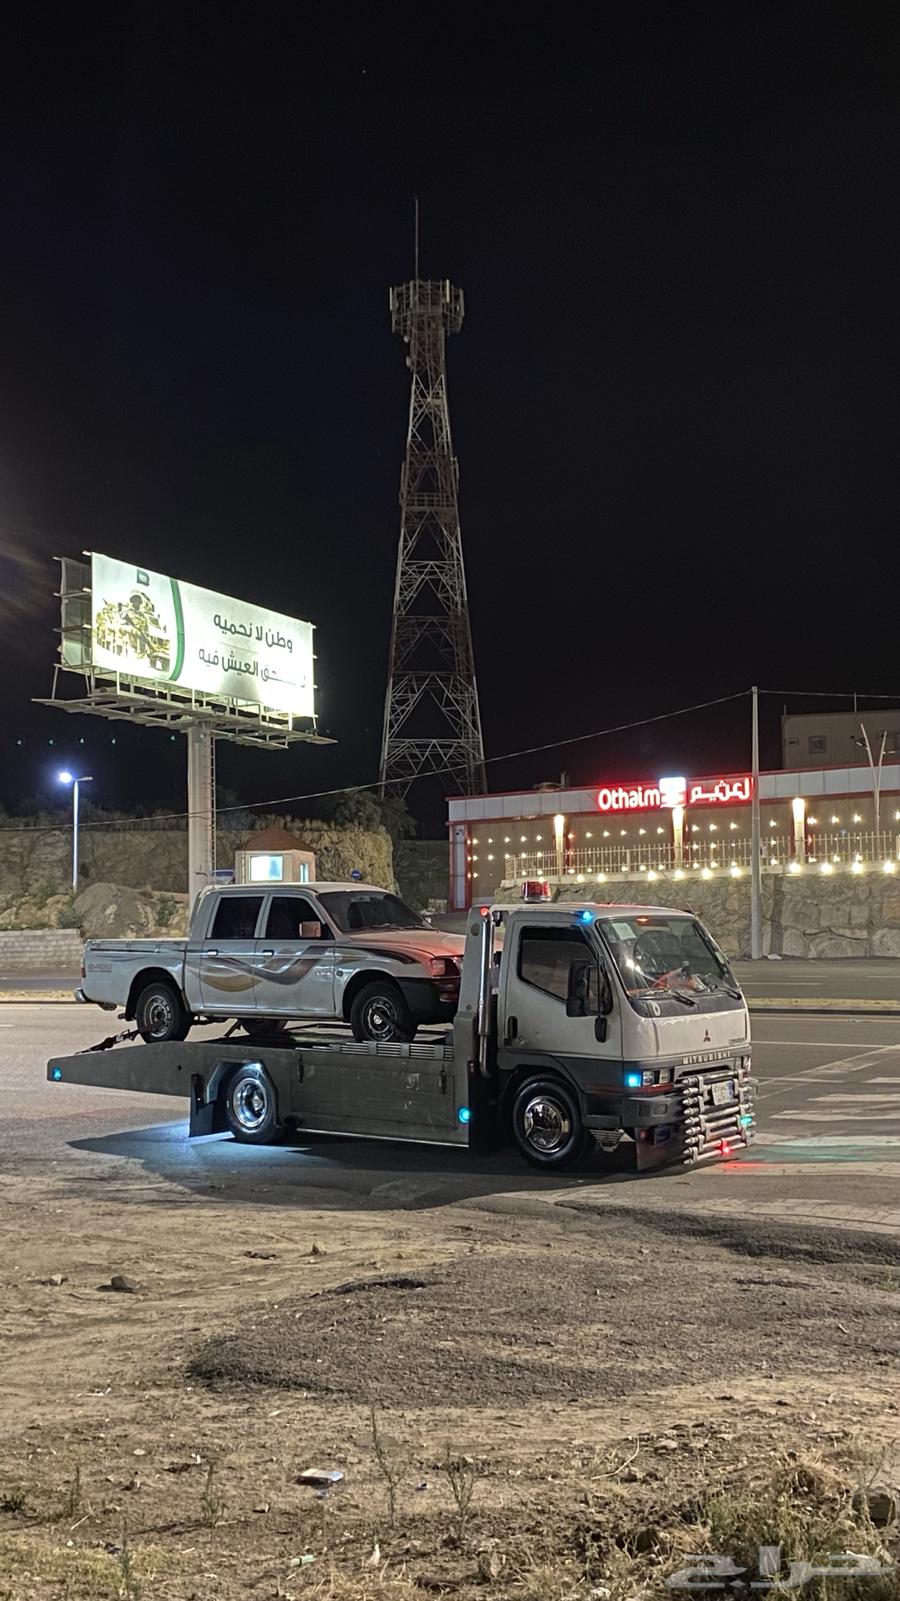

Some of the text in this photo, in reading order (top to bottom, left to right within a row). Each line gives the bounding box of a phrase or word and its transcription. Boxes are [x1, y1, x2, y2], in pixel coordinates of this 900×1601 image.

[213, 614, 293, 653] وطن لا نحميه
[198, 648, 220, 667] فيه
[222, 651, 259, 676] العيش
[598, 786, 661, 810] Othaim
[683, 1051, 730, 1064] MITSUBISHI
